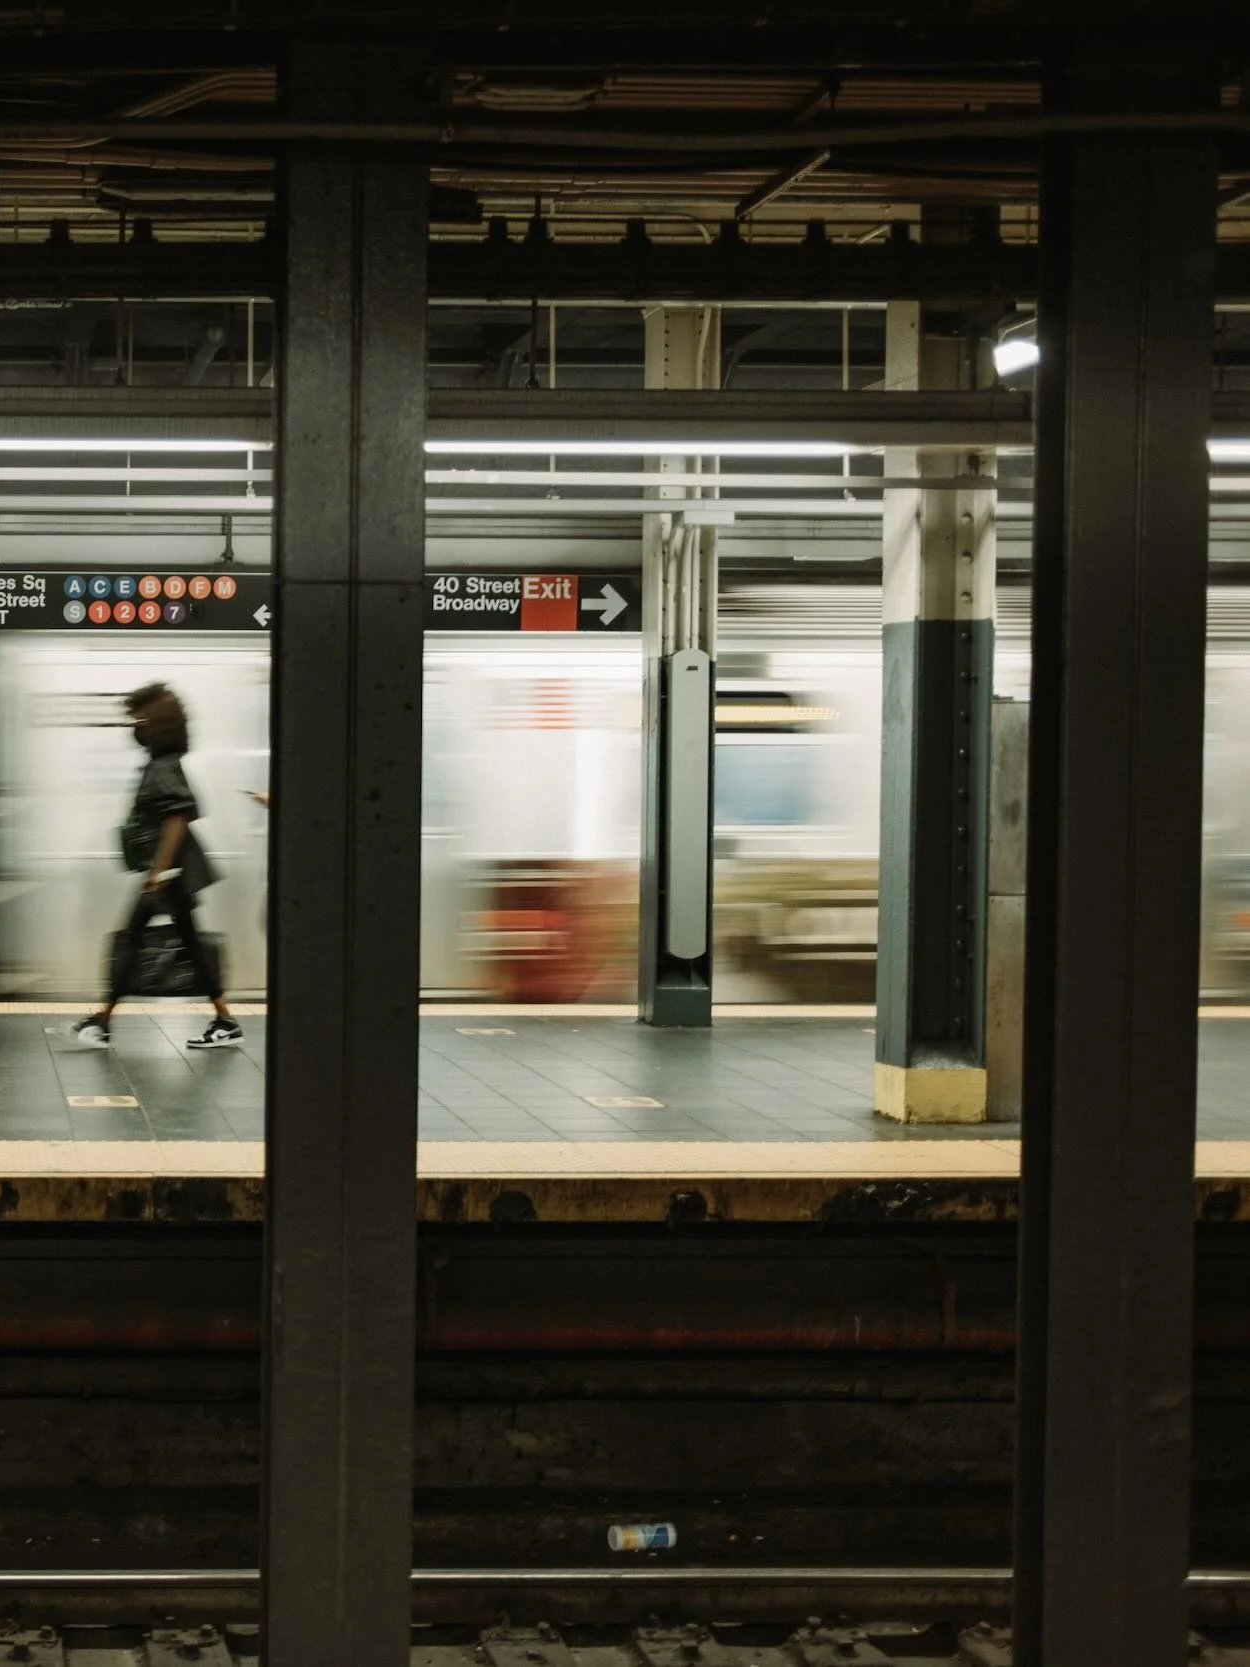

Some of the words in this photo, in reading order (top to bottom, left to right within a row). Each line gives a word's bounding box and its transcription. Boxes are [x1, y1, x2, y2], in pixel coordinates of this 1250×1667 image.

[22, 574, 46, 593] Sq
[433, 577, 459, 593] 40
[466, 577, 521, 593] Street
[523, 577, 572, 600] Exit
[432, 594, 521, 614] Broadway
